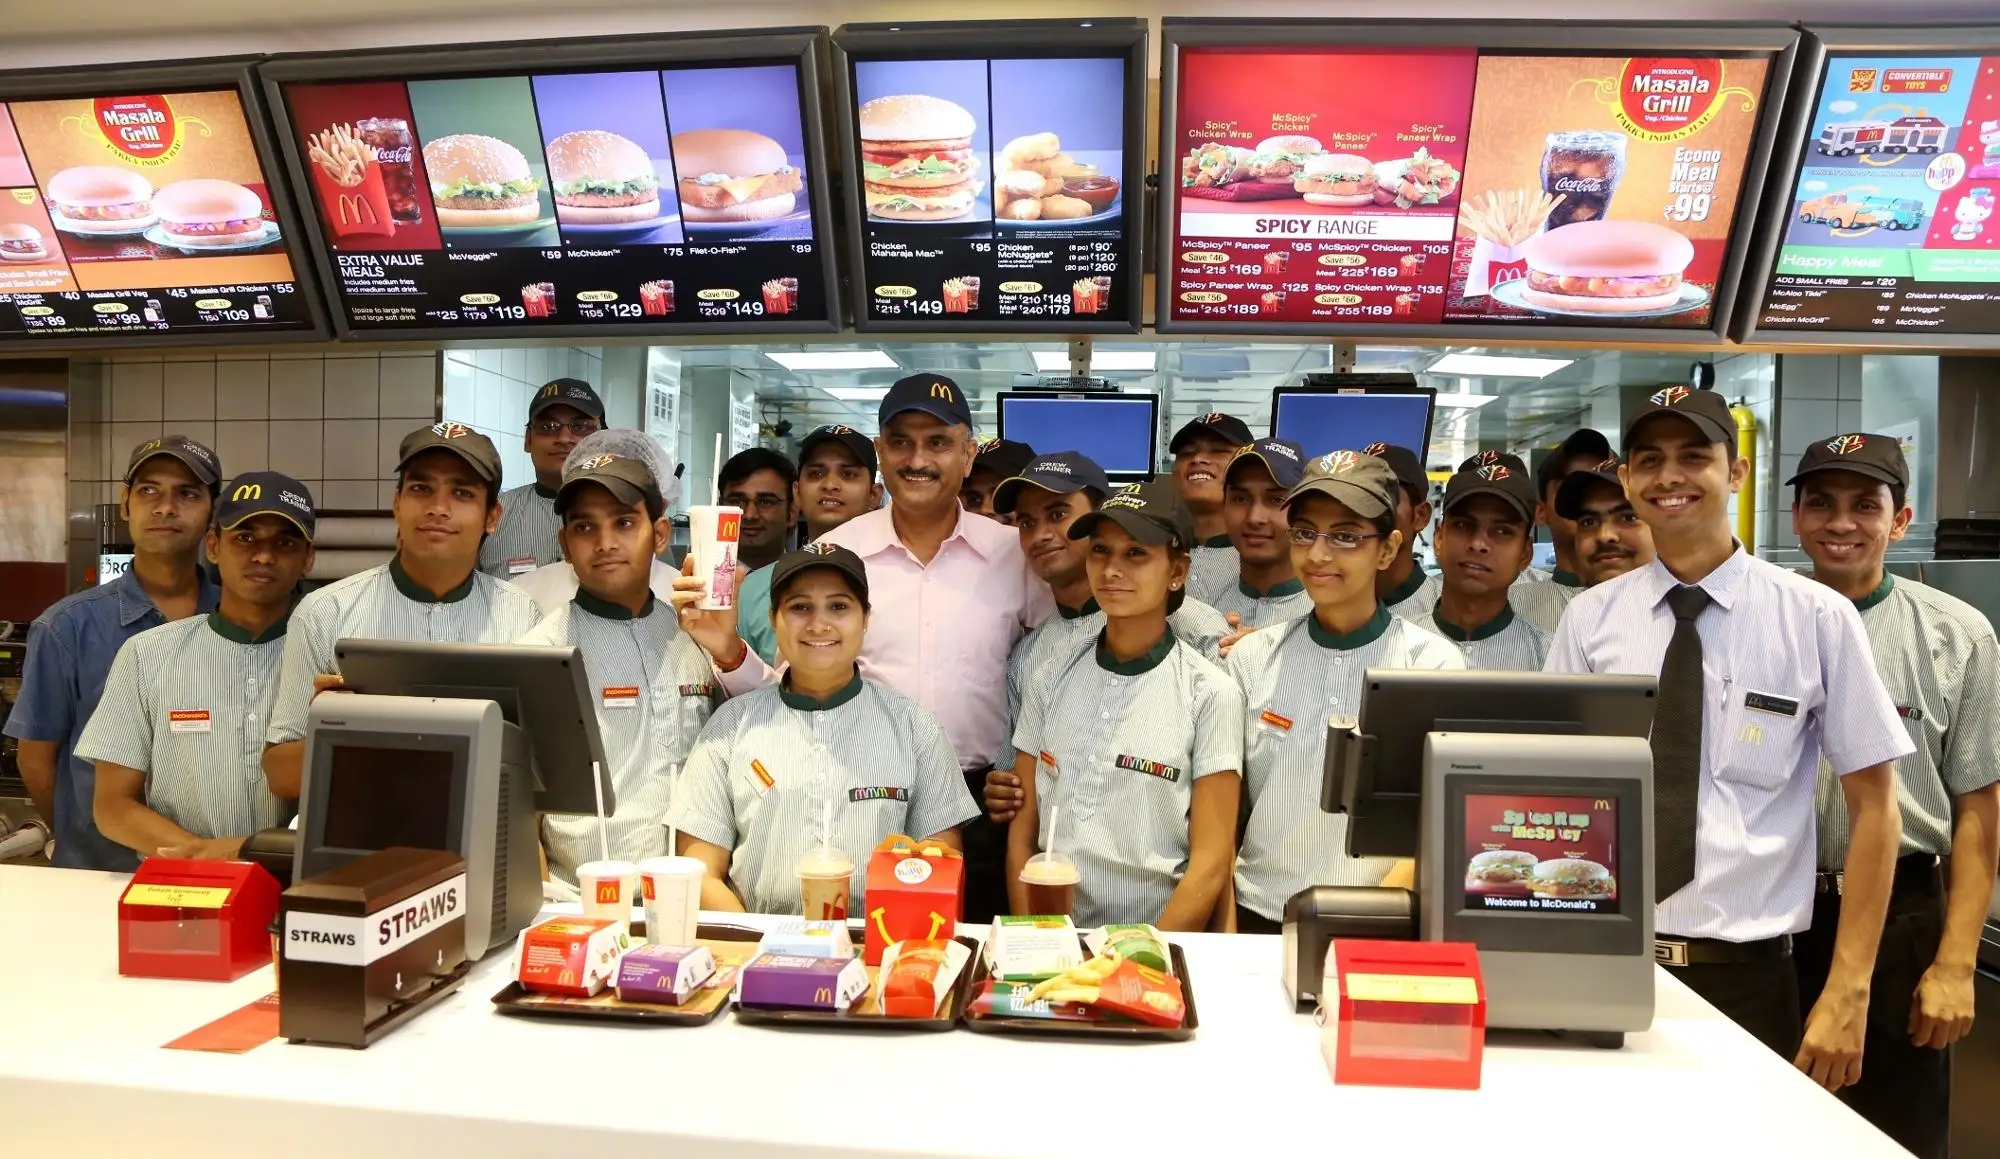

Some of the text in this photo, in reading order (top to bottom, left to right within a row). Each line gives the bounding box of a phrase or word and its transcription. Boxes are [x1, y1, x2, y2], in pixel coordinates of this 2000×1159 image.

[1888, 72, 1944, 81] CONVERTIBLE
[1631, 74, 1710, 93] Masala
[1905, 81, 1926, 90] TOYS
[1643, 95, 1692, 113] Grill
[102, 108, 167, 126] Masala
[1271, 122, 1310, 131] Chicken
[120, 126, 160, 142] Grill
[1189, 130, 1253, 140] Chicken Wrap
[1397, 133, 1457, 144] Paneer Wrap
[1334, 142, 1369, 150] Paneer
[1675, 146, 1721, 162] Econo
[1671, 162, 1720, 181] Meal
[1256, 219, 1379, 235] SPICY RANGE
[870, 242, 907, 251] Chicken
[997, 243, 1034, 251] Chicken
[1234, 241, 1271, 250] Paneer
[1371, 244, 1412, 253] Chicken
[871, 250, 914, 259] Maharaja
[1188, 253, 1208, 261] Save
[337, 254, 424, 267] EXTRA VALUE
[1324, 256, 1344, 264] Save
[1783, 254, 1836, 269] Happy
[340, 266, 385, 277] MEALS
[1180, 266, 1201, 274] Meal
[1315, 269, 1336, 277] Meal
[236, 285, 269, 293] Chicken
[1180, 281, 1207, 290] Spicy
[1208, 281, 1244, 290] Paneer
[1245, 282, 1274, 292] Wrap
[1314, 283, 1341, 292] Spicy
[1343, 283, 1384, 292] Chicken
[1385, 284, 1413, 294] Wrap
[704, 291, 720, 299] Save
[880, 288, 898, 296] Save
[1773, 289, 1802, 297] McAloo
[465, 295, 482, 303] Save
[1187, 293, 1206, 301] Save
[1321, 295, 1340, 303] Save
[1179, 306, 1199, 314] Meal
[1764, 315, 1796, 323] Chicken
[1271, 442, 1296, 454] CREW
[1264, 445, 1299, 462] TRAINER
[1033, 466, 1072, 475] TRAINER
[282, 490, 307, 504] CREW
[278, 494, 311, 513] TRAINER
[1484, 896, 1597, 909] Welcome to McDonald's
[378, 886, 458, 947] STRAWS
[290, 928, 356, 947] STRAWS
